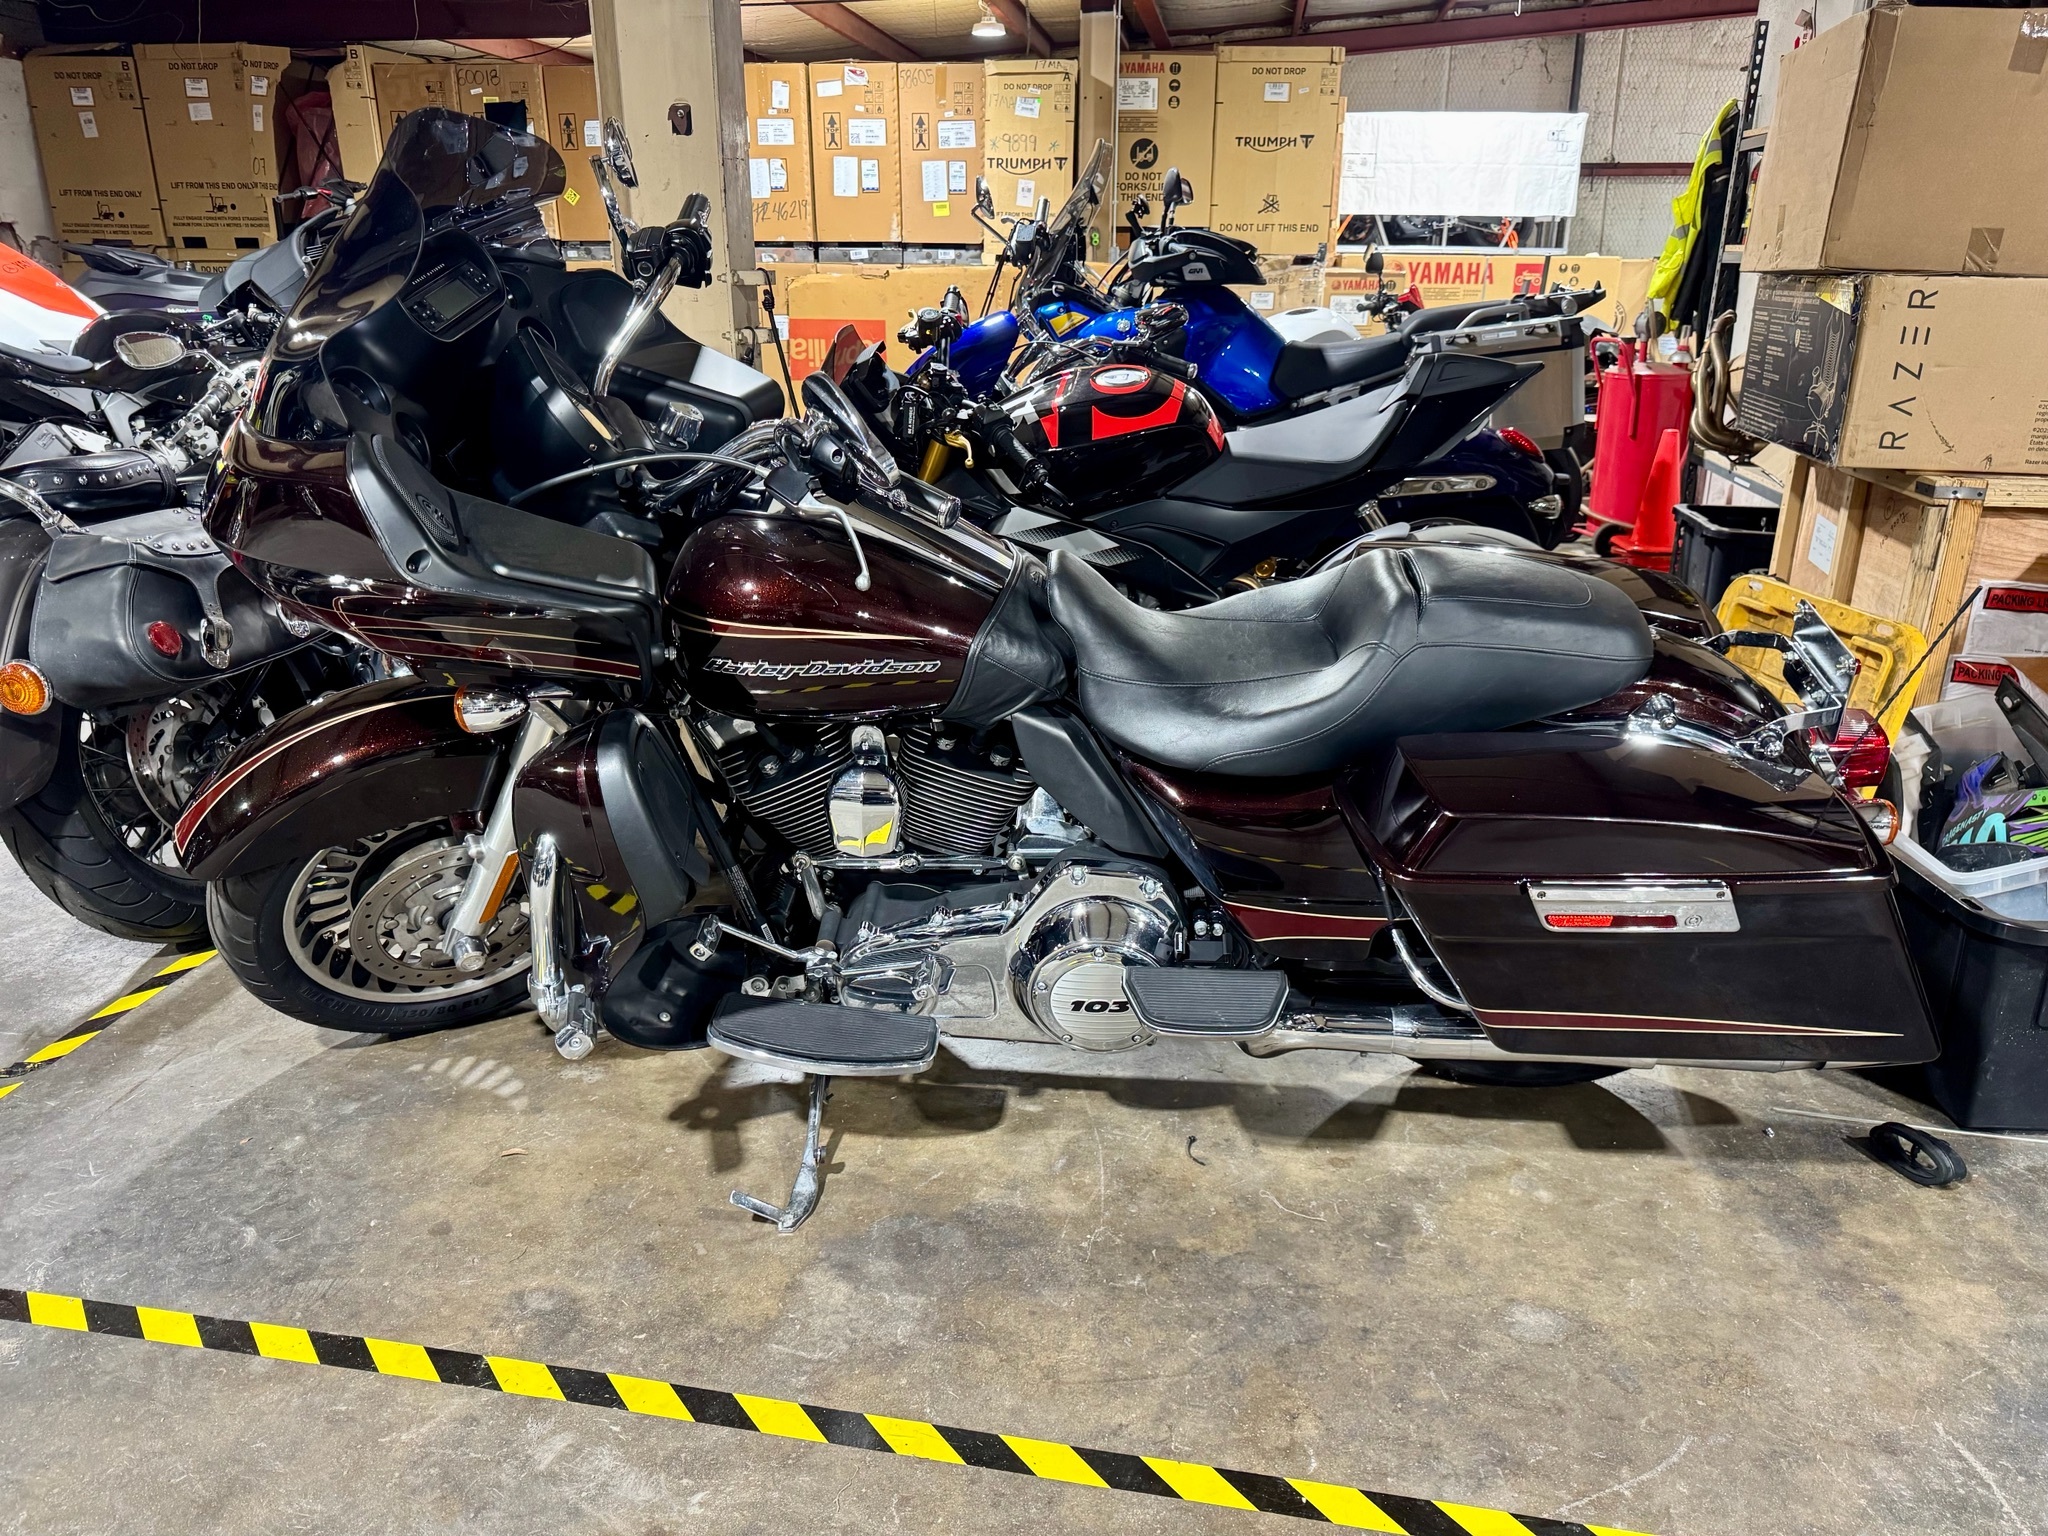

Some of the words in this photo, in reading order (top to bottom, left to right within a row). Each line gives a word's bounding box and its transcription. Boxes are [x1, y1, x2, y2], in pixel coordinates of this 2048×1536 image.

[350, 49, 358, 59] B
[121, 61, 129, 71] B
[264, 61, 279, 70] DROP
[1124, 62, 1165, 73] YAMAHA
[457, 68, 500, 86] 60018
[899, 68, 935, 89] 58605
[1063, 73, 1070, 82] A
[1000, 134, 1037, 152] 9899
[1235, 137, 1297, 150] TRIUMPH
[986, 158, 1051, 172] TRIUMPH
[1125, 172, 1139, 180] DO
[1142, 172, 1162, 180] NOT
[1256, 224, 1276, 232] LIFT
[1278, 224, 1297, 232] THIS
[1300, 224, 1318, 232] END
[1408, 262, 1494, 284] YAMAHA
[1341, 280, 1379, 290] YAMAHA
[1878, 290, 1939, 450] RAZER
[1991, 594, 2034, 606] PACKING
[704, 658, 941, 680] Harley-Davidson
[1958, 667, 2001, 680] PACKING
[1070, 1000, 1130, 1013] 103
